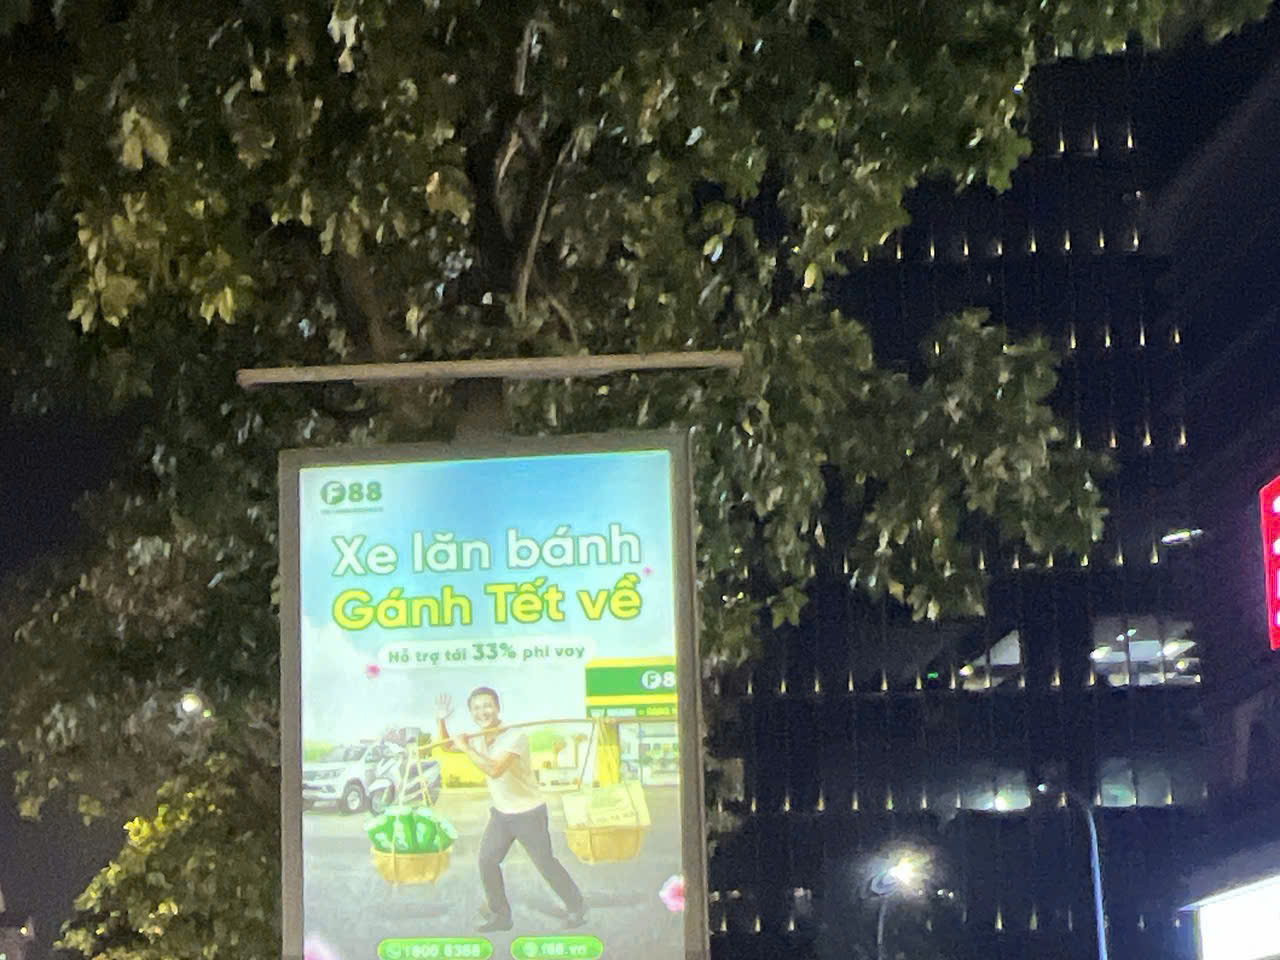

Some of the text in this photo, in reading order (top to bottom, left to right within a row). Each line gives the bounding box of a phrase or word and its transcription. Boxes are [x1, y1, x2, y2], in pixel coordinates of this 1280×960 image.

[320, 481, 382, 505] F88
[332, 523, 641, 576] Xe lăn bánh
[333, 573, 642, 630] Gánh Tết về
[472, 642, 517, 660] 33%
[554, 646, 585, 659] vay
